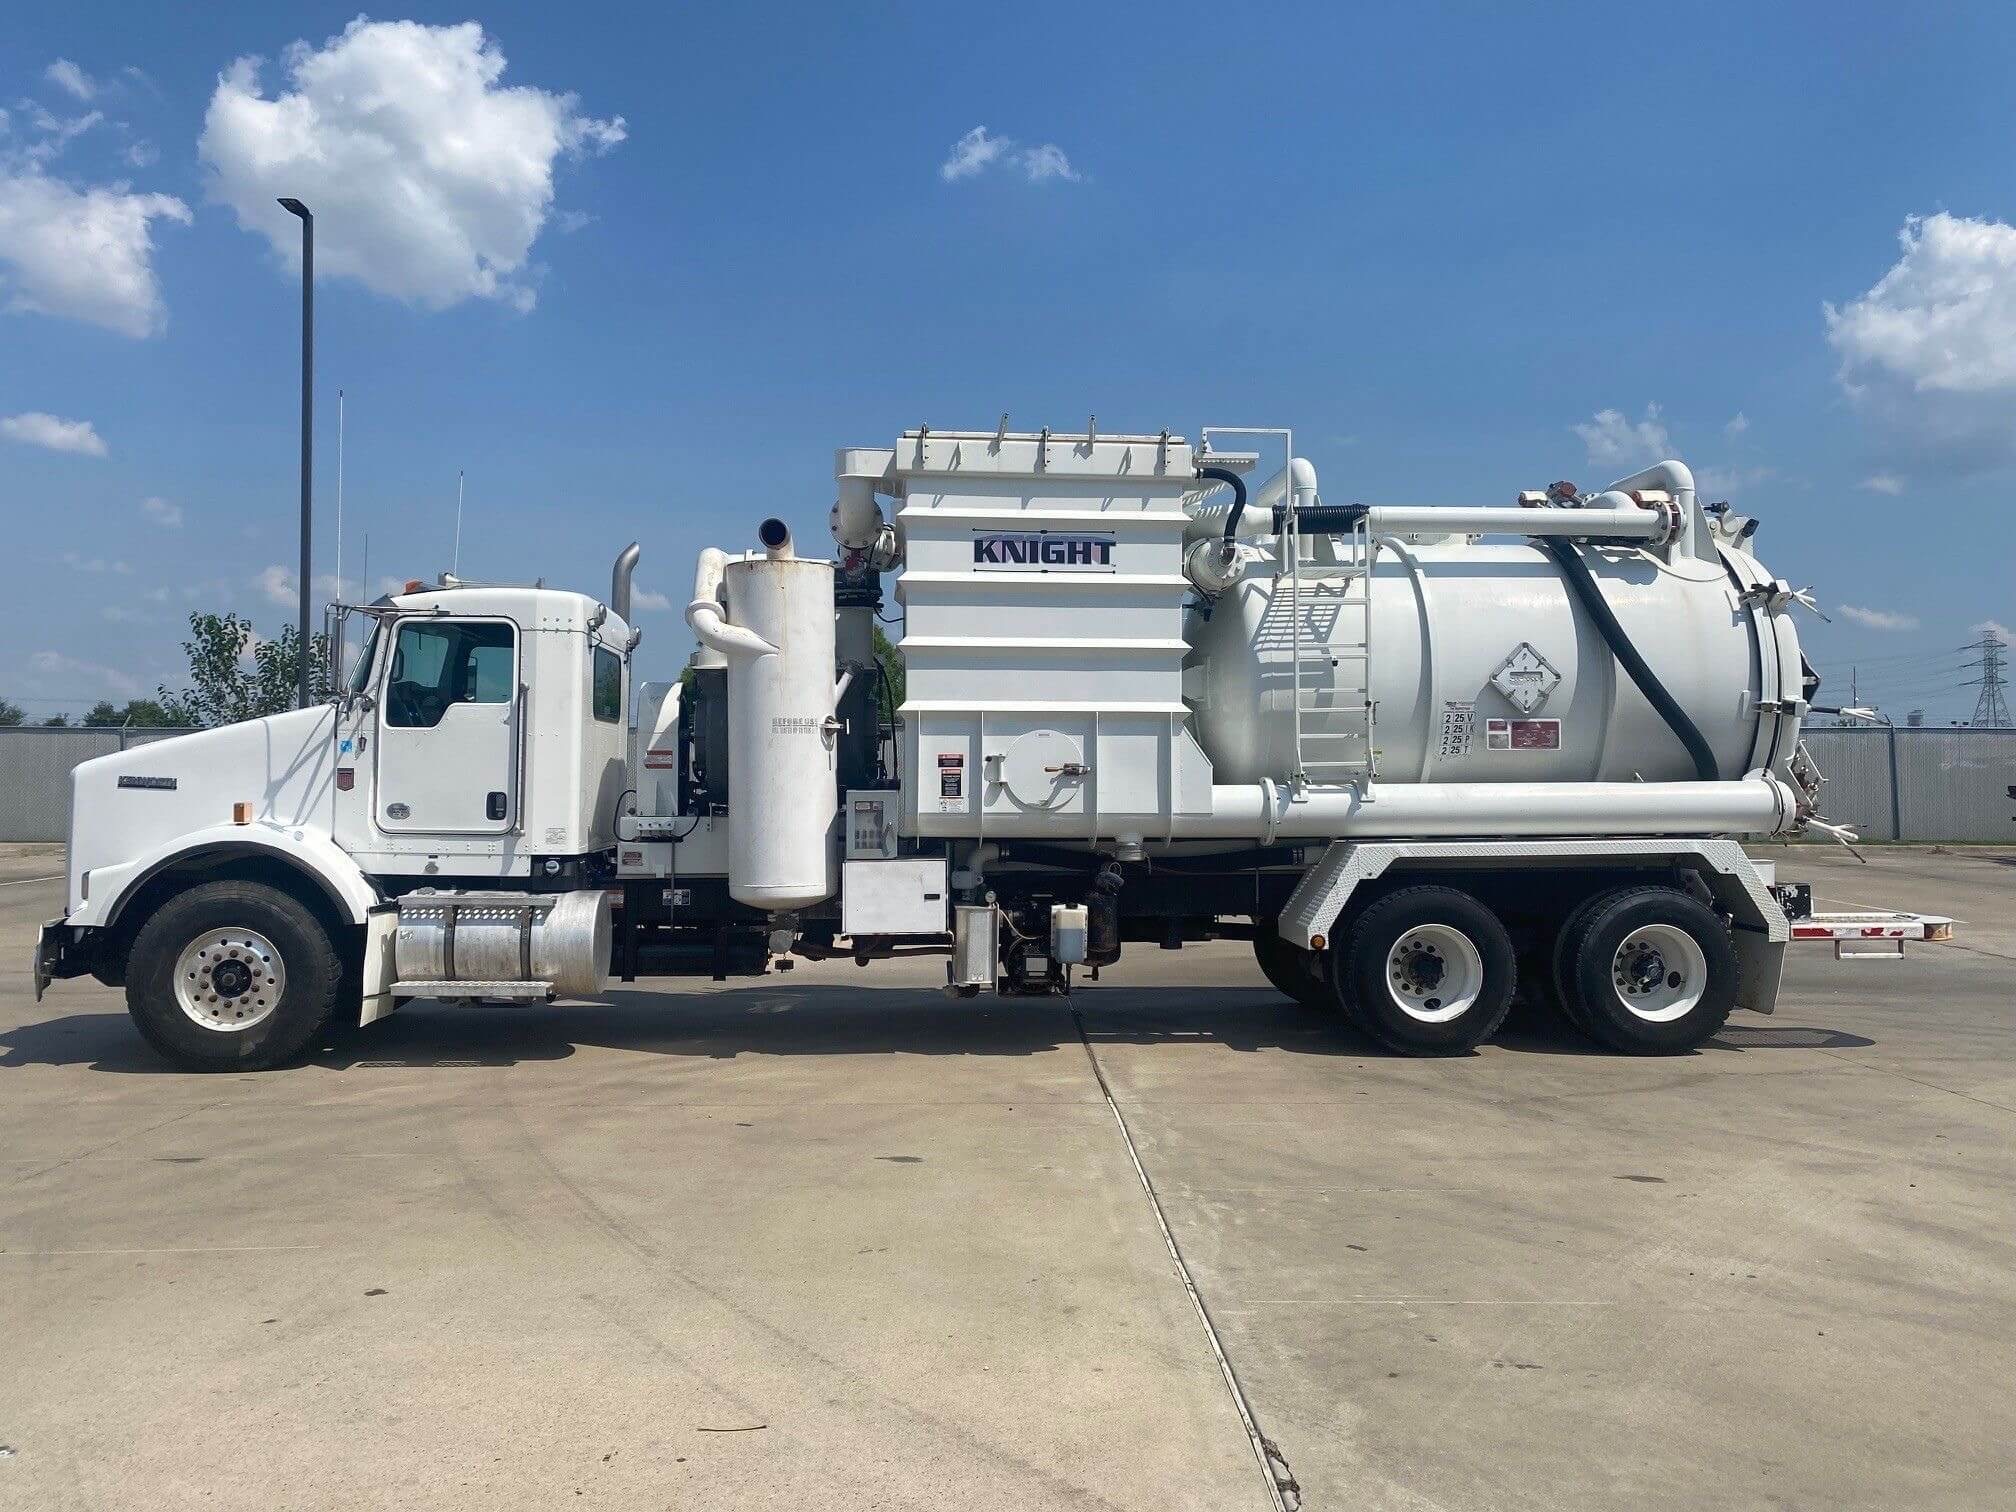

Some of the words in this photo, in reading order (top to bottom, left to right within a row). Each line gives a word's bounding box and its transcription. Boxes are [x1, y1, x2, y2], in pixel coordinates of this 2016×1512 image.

[974, 539, 1116, 565] KNIGHT
[1445, 714, 1451, 723] 2
[1454, 713, 1465, 722] 25
[1467, 713, 1474, 722] V
[1444, 725, 1450, 734] 2
[1453, 724, 1463, 733] 25
[1443, 736, 1449, 745] 2
[1451, 735, 1462, 744] 25
[1441, 746, 1447, 755] 2
[1450, 745, 1460, 754] 25
